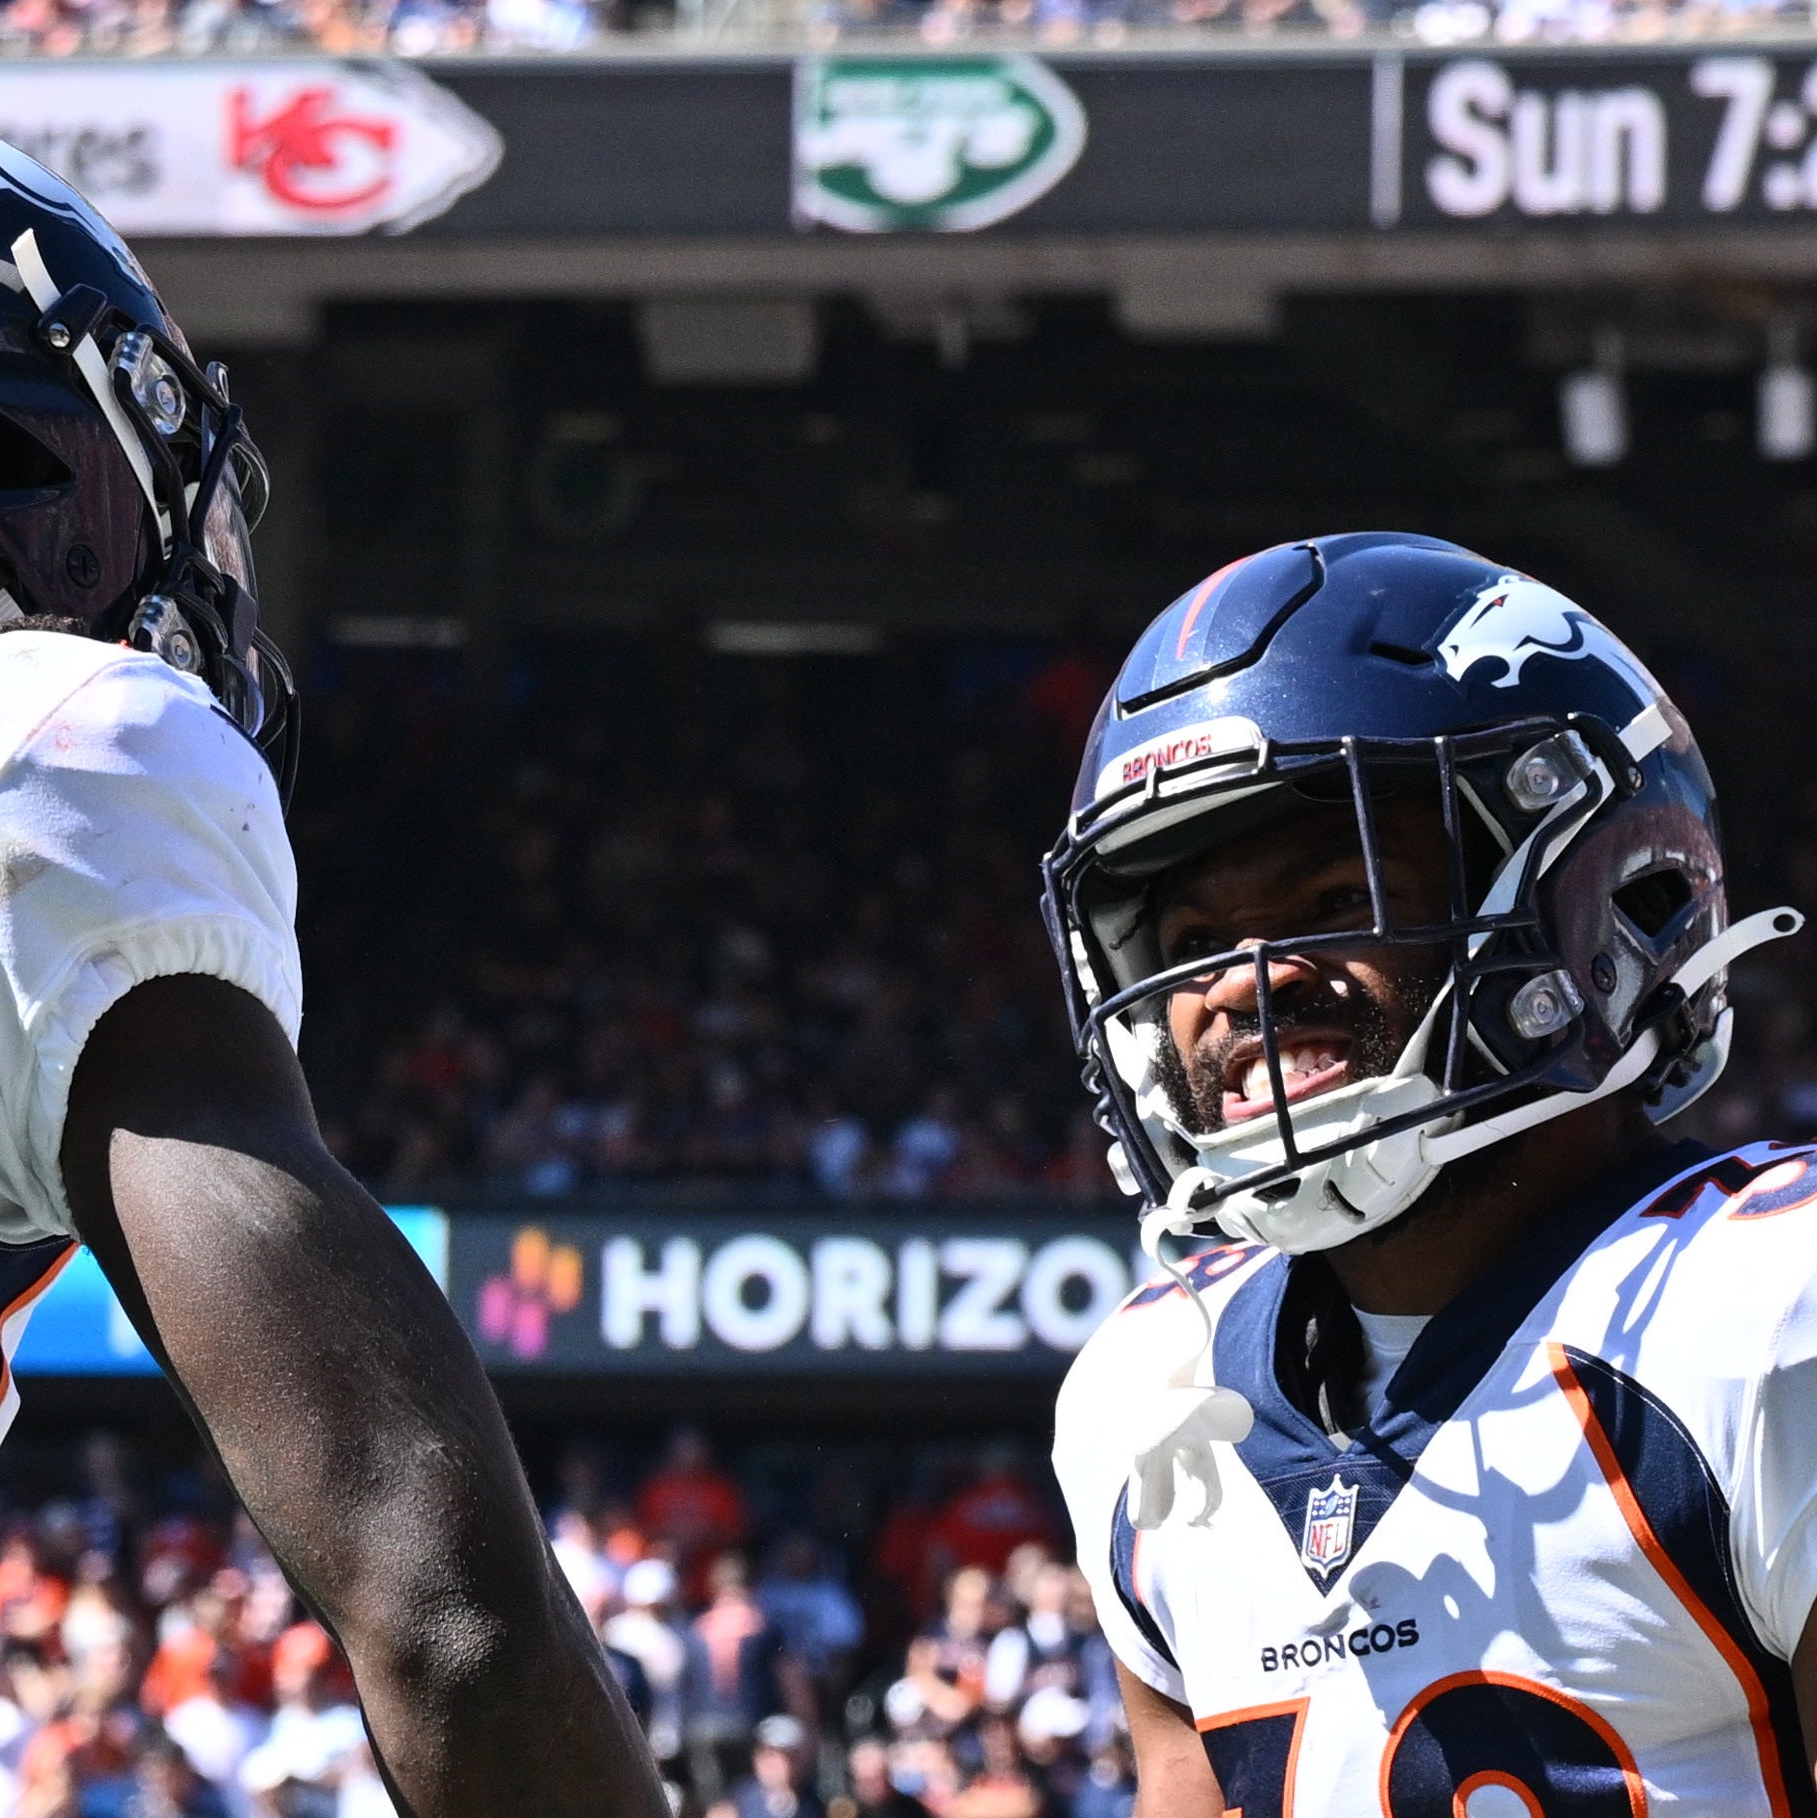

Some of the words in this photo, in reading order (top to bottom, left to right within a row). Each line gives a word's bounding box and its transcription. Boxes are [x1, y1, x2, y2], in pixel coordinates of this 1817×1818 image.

[1426, 57, 1666, 216] Sun
[1122, 733, 1213, 784] BRONCOS
[601, 1232, 1140, 1353] HORIZO
[1309, 1522, 1344, 1560] NFL
[1260, 1618, 1420, 1673] BRONCOS
